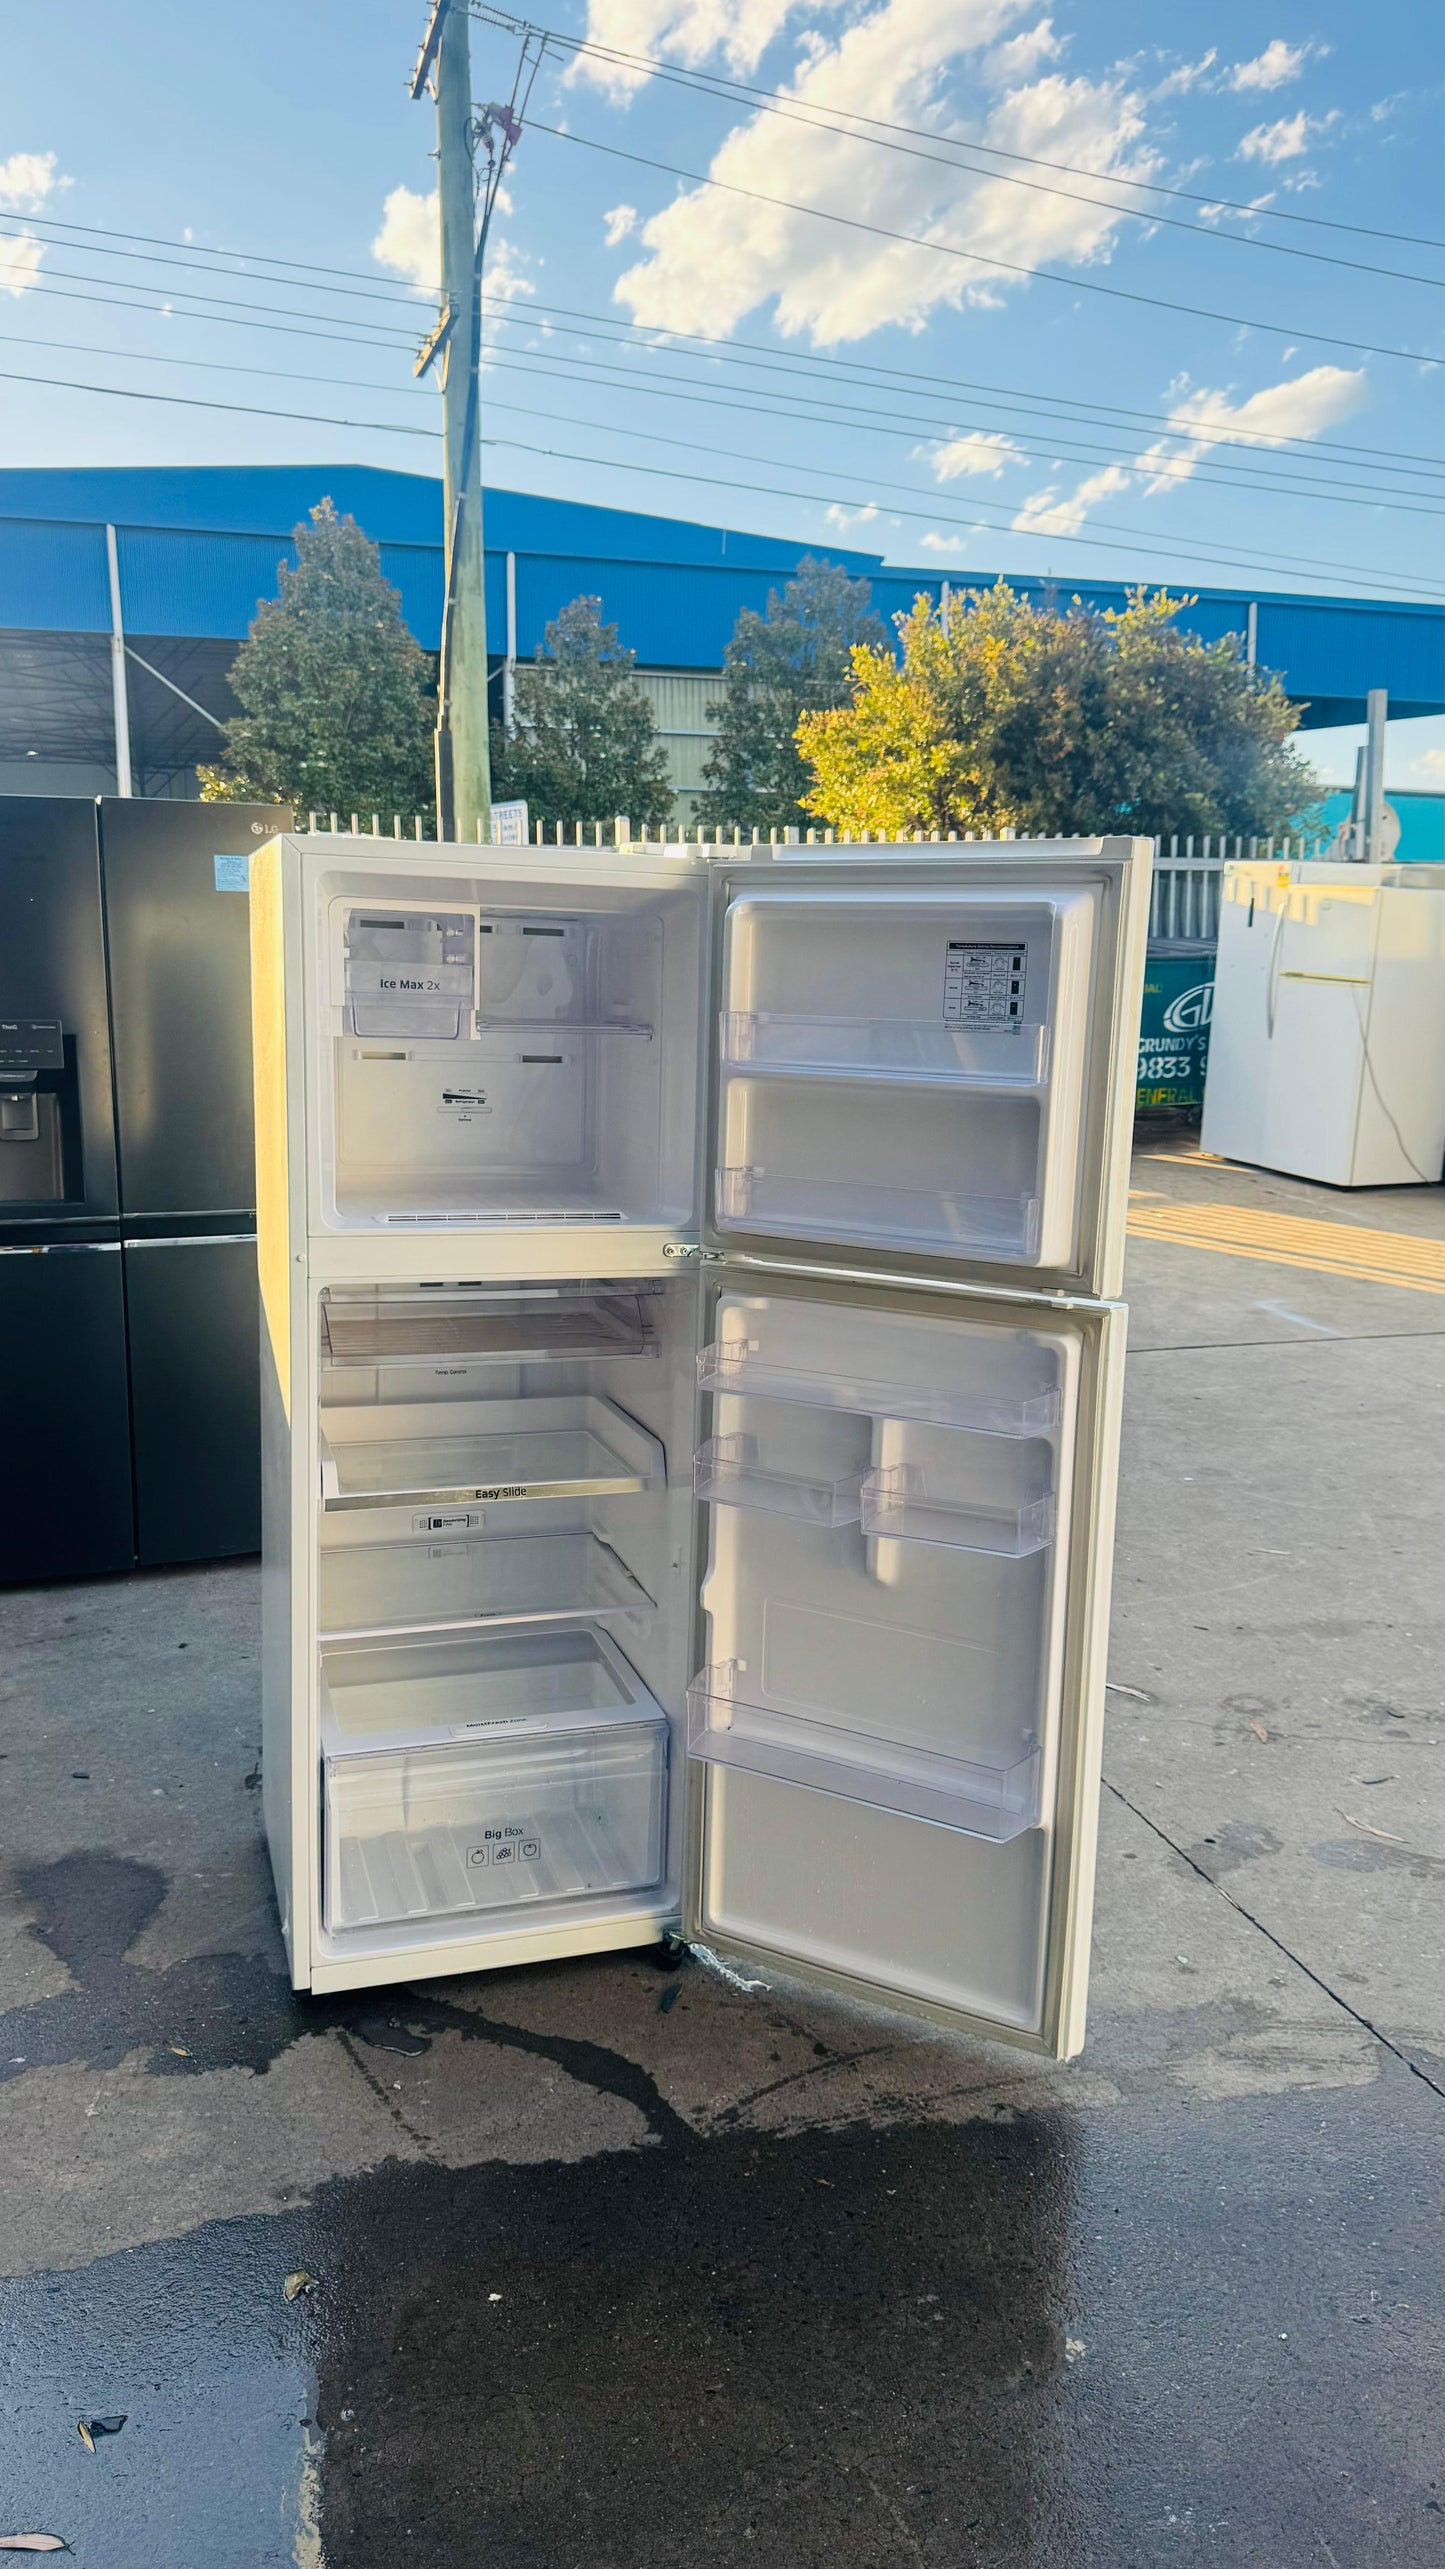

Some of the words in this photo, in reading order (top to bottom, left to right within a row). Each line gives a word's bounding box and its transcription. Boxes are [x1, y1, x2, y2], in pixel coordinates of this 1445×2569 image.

[264, 824, 279, 834] LG
[380, 979, 397, 989] Ice
[400, 980, 424, 990] Max
[427, 981, 440, 991] 2x
[1138, 1036, 1206, 1052] GRUNDY'S
[1138, 1056, 1191, 1080] 9833
[1136, 1087, 1195, 1106] ENERAL
[475, 1489, 500, 1500] Easy
[503, 1487, 527, 1497] Slide
[484, 1830, 502, 1840] Big
[504, 1827, 524, 1837] Box
